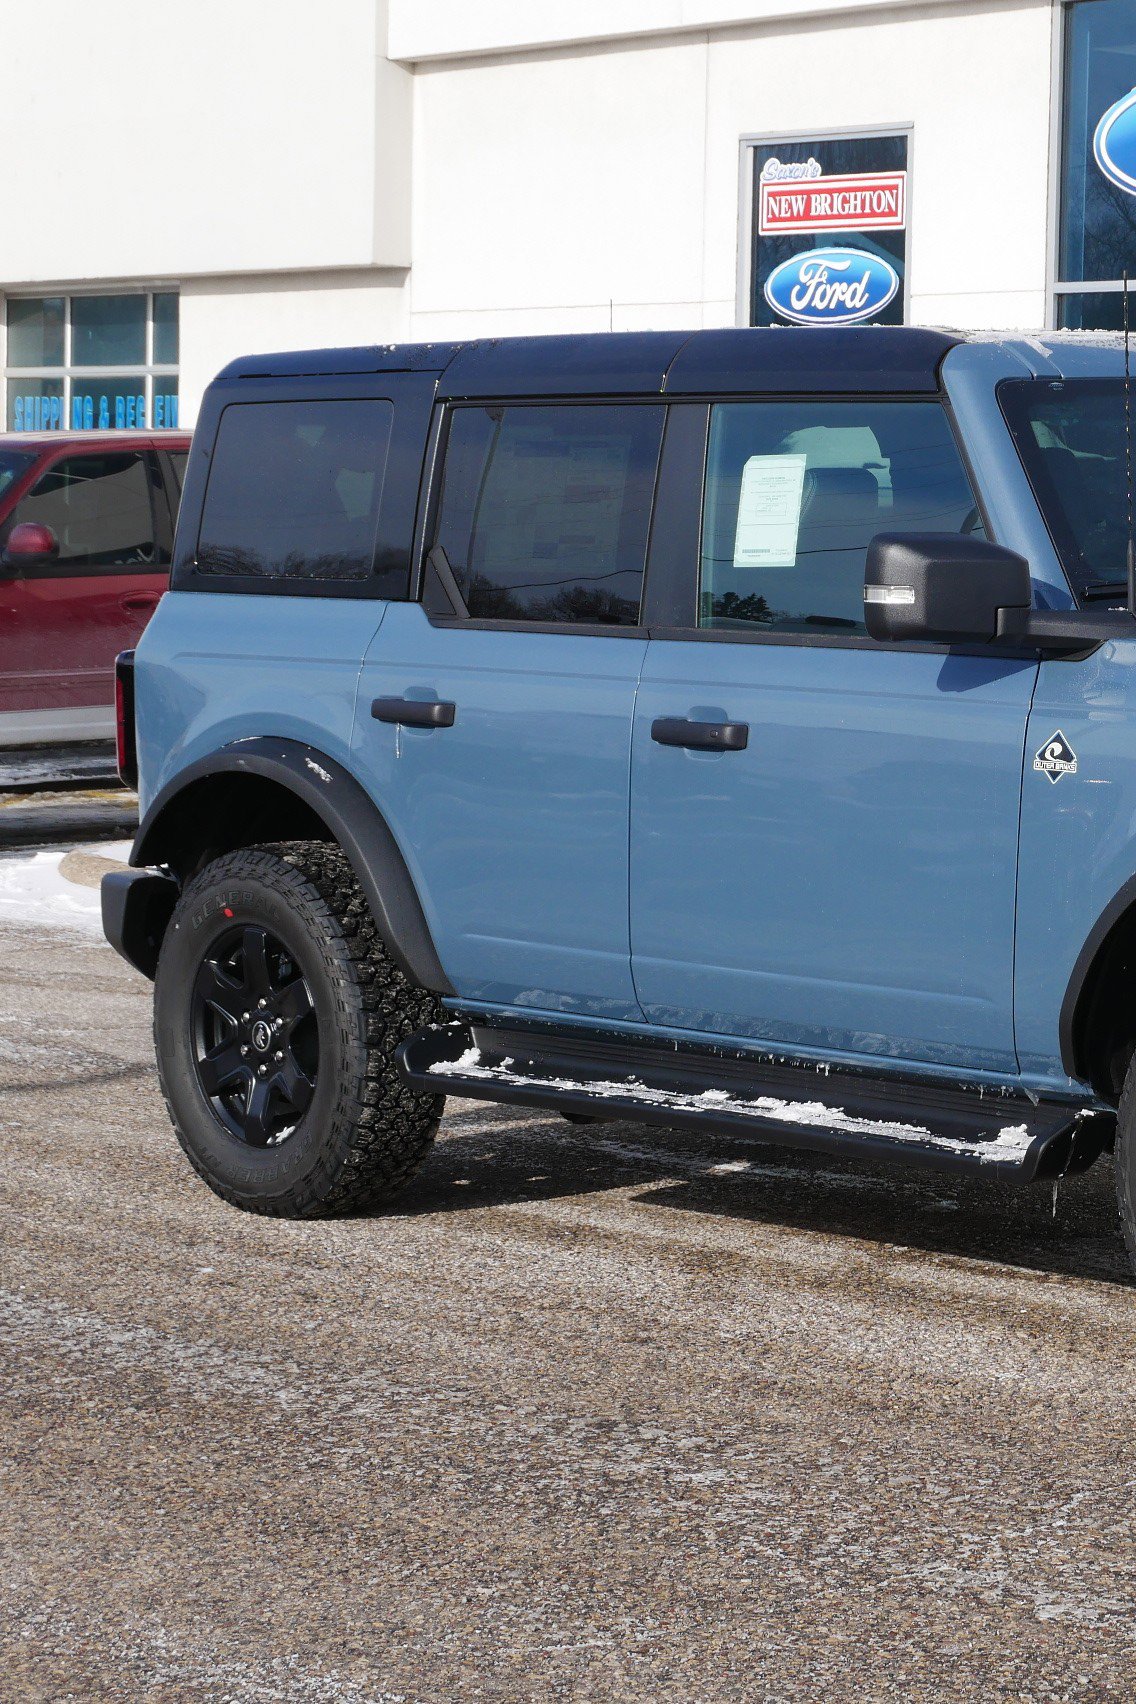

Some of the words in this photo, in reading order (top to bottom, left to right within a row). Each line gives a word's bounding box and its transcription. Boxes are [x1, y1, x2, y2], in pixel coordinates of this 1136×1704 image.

[763, 160, 821, 181] Saxon's
[767, 195, 807, 219] NEW
[810, 189, 898, 216] BRIGHTON
[790, 259, 872, 311] Ford
